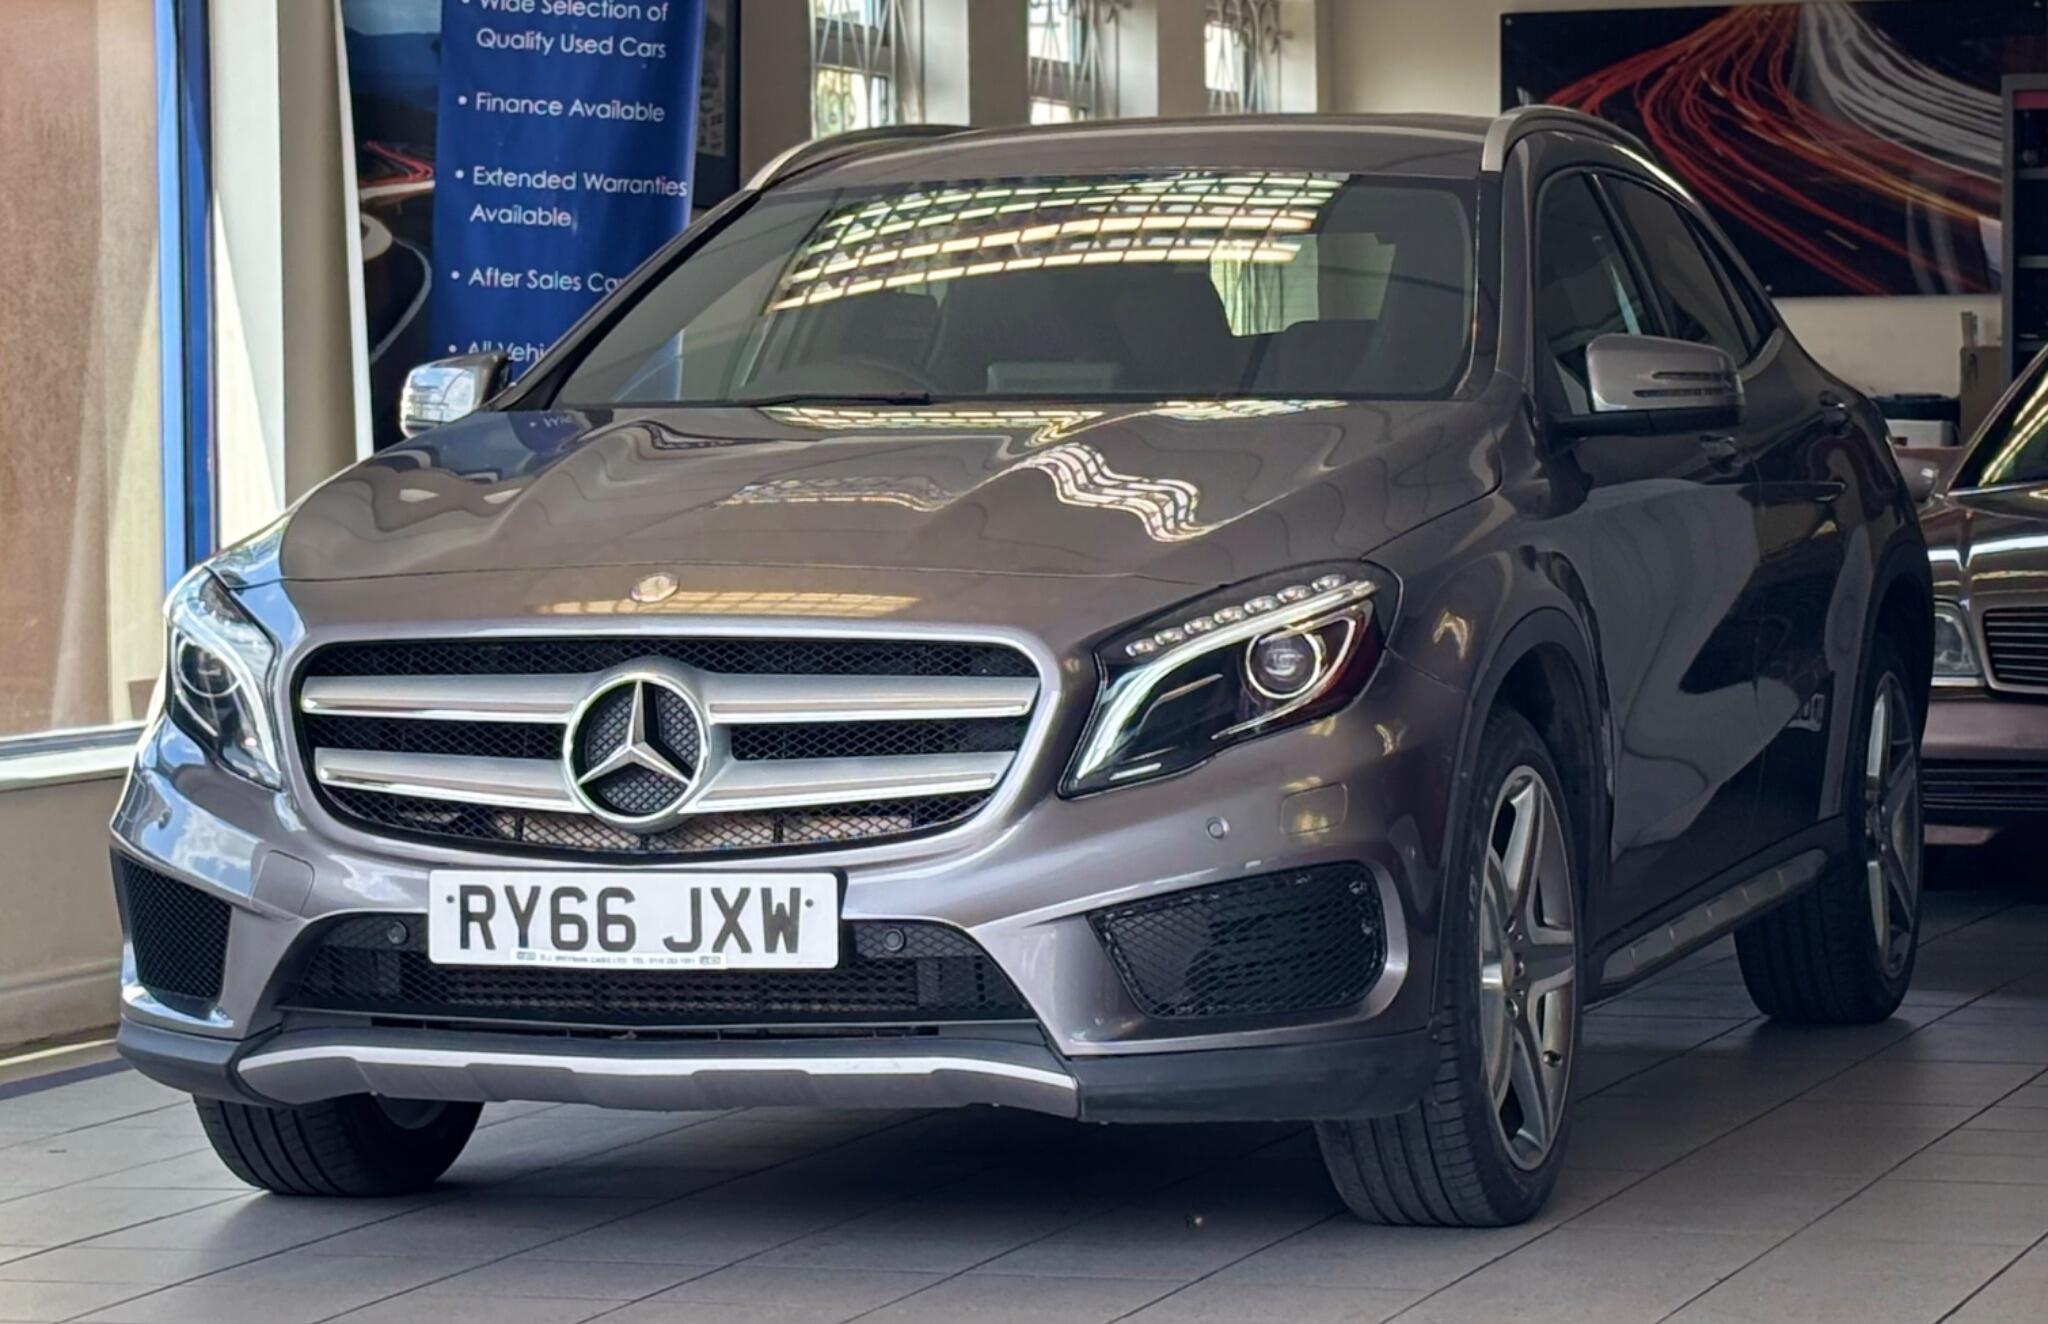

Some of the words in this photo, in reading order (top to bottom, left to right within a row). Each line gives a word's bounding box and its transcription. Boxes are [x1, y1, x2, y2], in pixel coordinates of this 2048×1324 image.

[541, 0, 640, 20] Selection
[647, 2, 669, 22] of
[476, 28, 555, 55] Quality
[560, 34, 613, 55] Used
[620, 37, 666, 59] Cars
[475, 92, 563, 116] Finance
[568, 98, 665, 122] Available
[473, 166, 576, 191] Extended
[583, 172, 688, 198] Warranties
[470, 204, 571, 227] Available
[468, 267, 522, 288] After
[526, 269, 582, 291] Sales
[497, 342, 549, 362] Vehi
[459, 885, 636, 952] RY66
[662, 887, 801, 954] JXW
